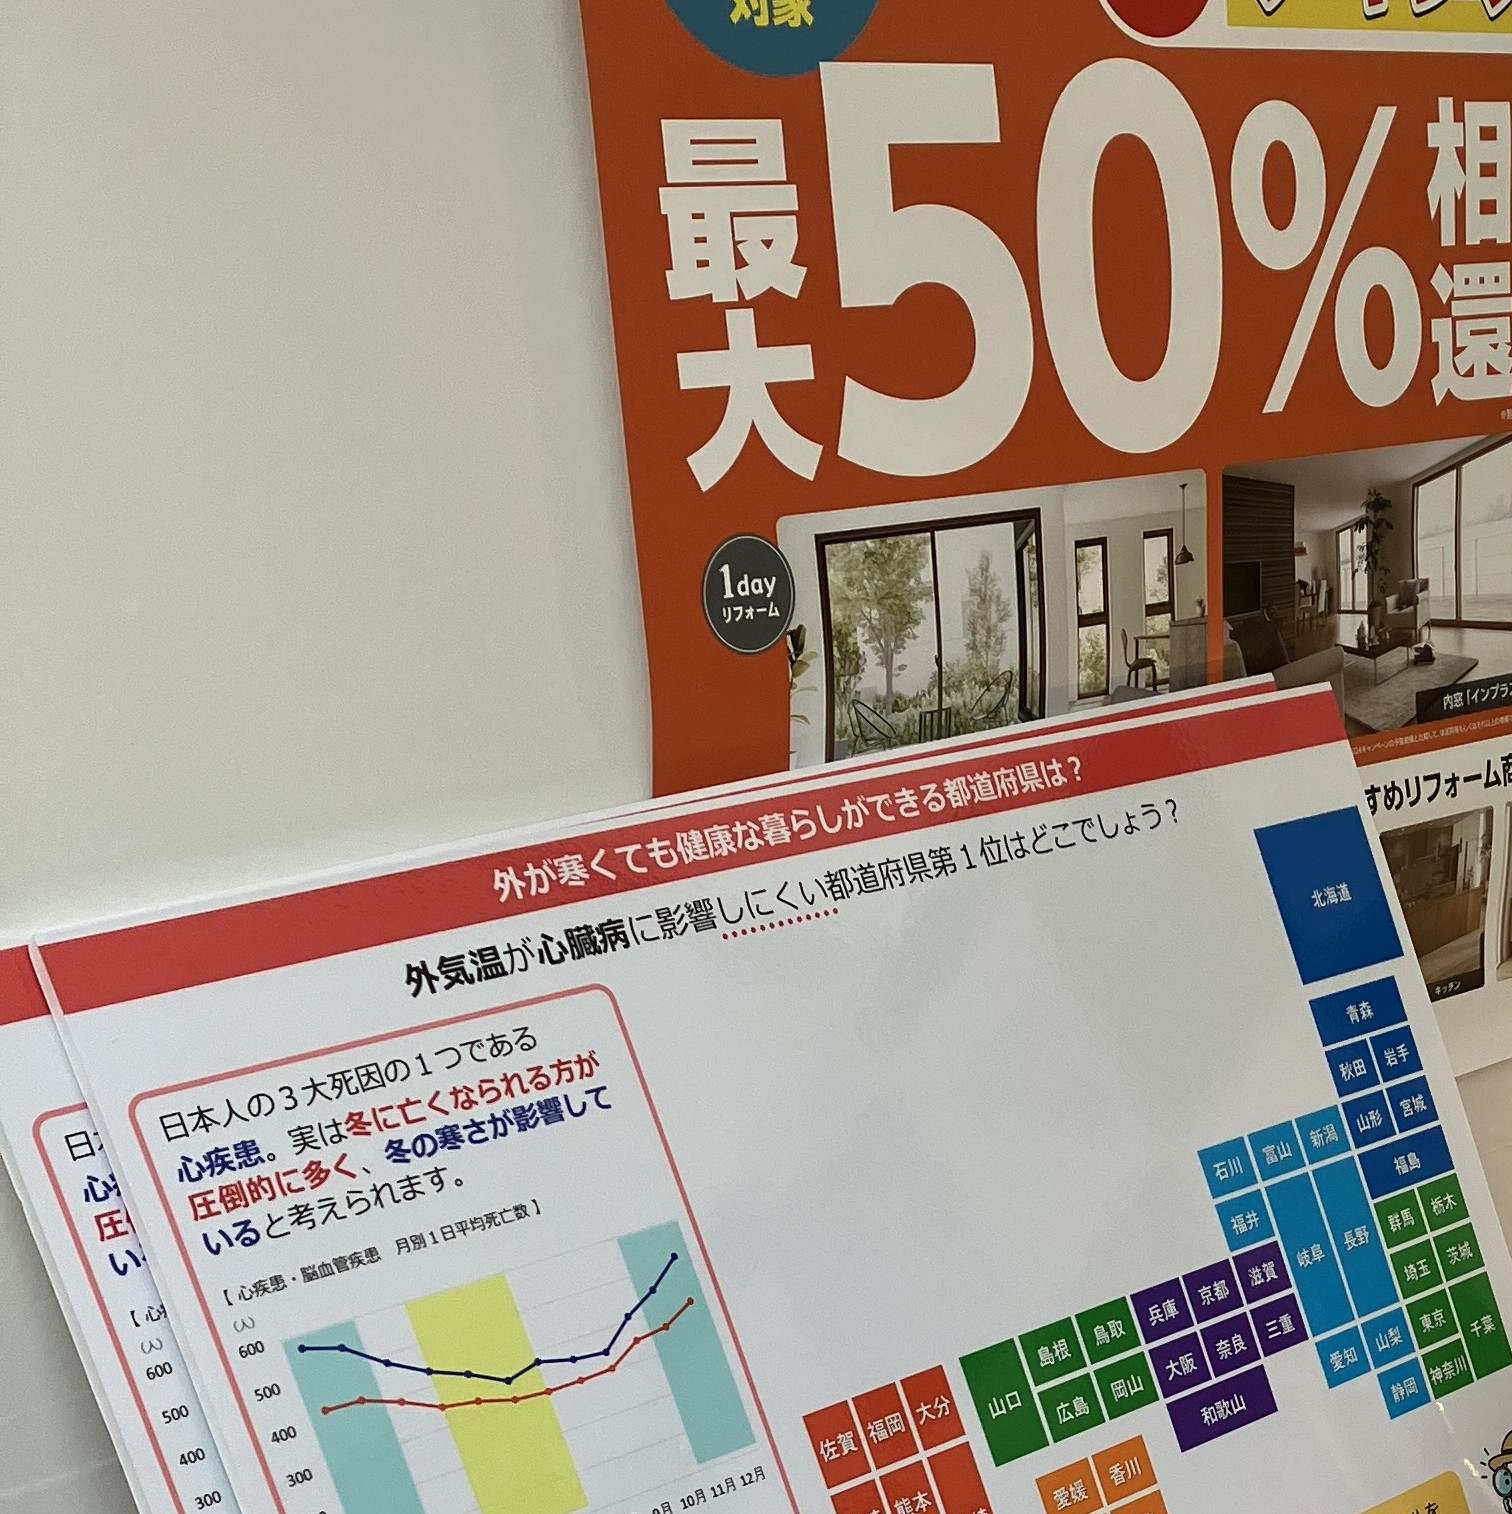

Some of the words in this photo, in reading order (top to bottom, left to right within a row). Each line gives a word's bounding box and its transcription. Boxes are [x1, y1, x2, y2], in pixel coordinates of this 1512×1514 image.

[658, 118, 825, 493] 最大
[818, 57, 1422, 478] 50%
[718, 564, 777, 599] 1day
[722, 602, 780, 624] リフォーム
[491, 757, 1084, 905] 外が寒くても健康な暮らしができる都道府県は?
[404, 799, 1180, 999] 外気温が心臓病に影響しにくい都道府県第1位はどこでしょう?
[1311, 883, 1352, 909] 北海道
[1433, 980, 1462, 996] キッチン
[1345, 1000, 1375, 1025] 青森
[1383, 1044, 1409, 1068] 岩手
[1338, 1058, 1367, 1082] 秋田
[159, 1026, 538, 1142] 日本人の3大死因の1つである
[176, 1051, 600, 1184] 心疾患。実は冬に亡くなられる方が
[1399, 1093, 1427, 1118] 宮城
[1356, 1107, 1383, 1132] 山形
[1308, 1123, 1339, 1148] 新潟
[187, 1085, 612, 1222] 圧倒的に多く、冬の寒さが影響して
[1265, 1138, 1293, 1165] 富山
[1393, 1151, 1421, 1176] 福島
[1214, 1157, 1243, 1182] 石川
[201, 1167, 464, 1256] いると考えられます。
[1430, 1193, 1458, 1217] 栃木
[1230, 1211, 1260, 1236] 福井
[1387, 1208, 1416, 1233] 群馬
[1343, 1226, 1370, 1251] 長野
[1296, 1245, 1326, 1270] 岐阜
[1446, 1241, 1474, 1266] 茨城
[1248, 1261, 1279, 1287] 滋賀
[1404, 1258, 1431, 1283] 埼玉
[1198, 1280, 1231, 1306] 京都
[1148, 1299, 1180, 1327] 兵庫
[1419, 1308, 1446, 1333] 東京
[1470, 1314, 1498, 1338] 千葉
[1093, 1319, 1127, 1347] 鳥取
[1266, 1313, 1296, 1340] 三重
[1375, 1326, 1404, 1352] 山梨
[238, 1340, 265, 1359] 600
[1038, 1339, 1072, 1368] 島根
[1215, 1333, 1248, 1361] 奈良
[1329, 1347, 1359, 1373] 愛知
[146, 1361, 173, 1381] 600
[1165, 1353, 1198, 1381] 大阪
[1429, 1355, 1468, 1386] 神奈川
[254, 1383, 281, 1402] 500
[1111, 1374, 1145, 1402] 岡山
[1391, 1376, 1419, 1404] 静岡
[162, 1404, 189, 1425] 500
[915, 1395, 952, 1425] 大分
[987, 1391, 1022, 1420] 山口
[1055, 1396, 1090, 1425] 広島
[1200, 1394, 1247, 1428] 和歌山
[271, 1425, 297, 1445] 400
[867, 1413, 907, 1445] 福岡
[178, 1447, 206, 1468] 400
[819, 1432, 860, 1463] 佐賀
[286, 1468, 313, 1488] 300
[1109, 1456, 1144, 1488] 香川
[194, 1490, 222, 1511] 300
[679, 1488, 707, 1511] 10月
[710, 1477, 737, 1499] 11月
[739, 1465, 767, 1488] 12月
[1053, 1479, 1090, 1511] 愛媛
